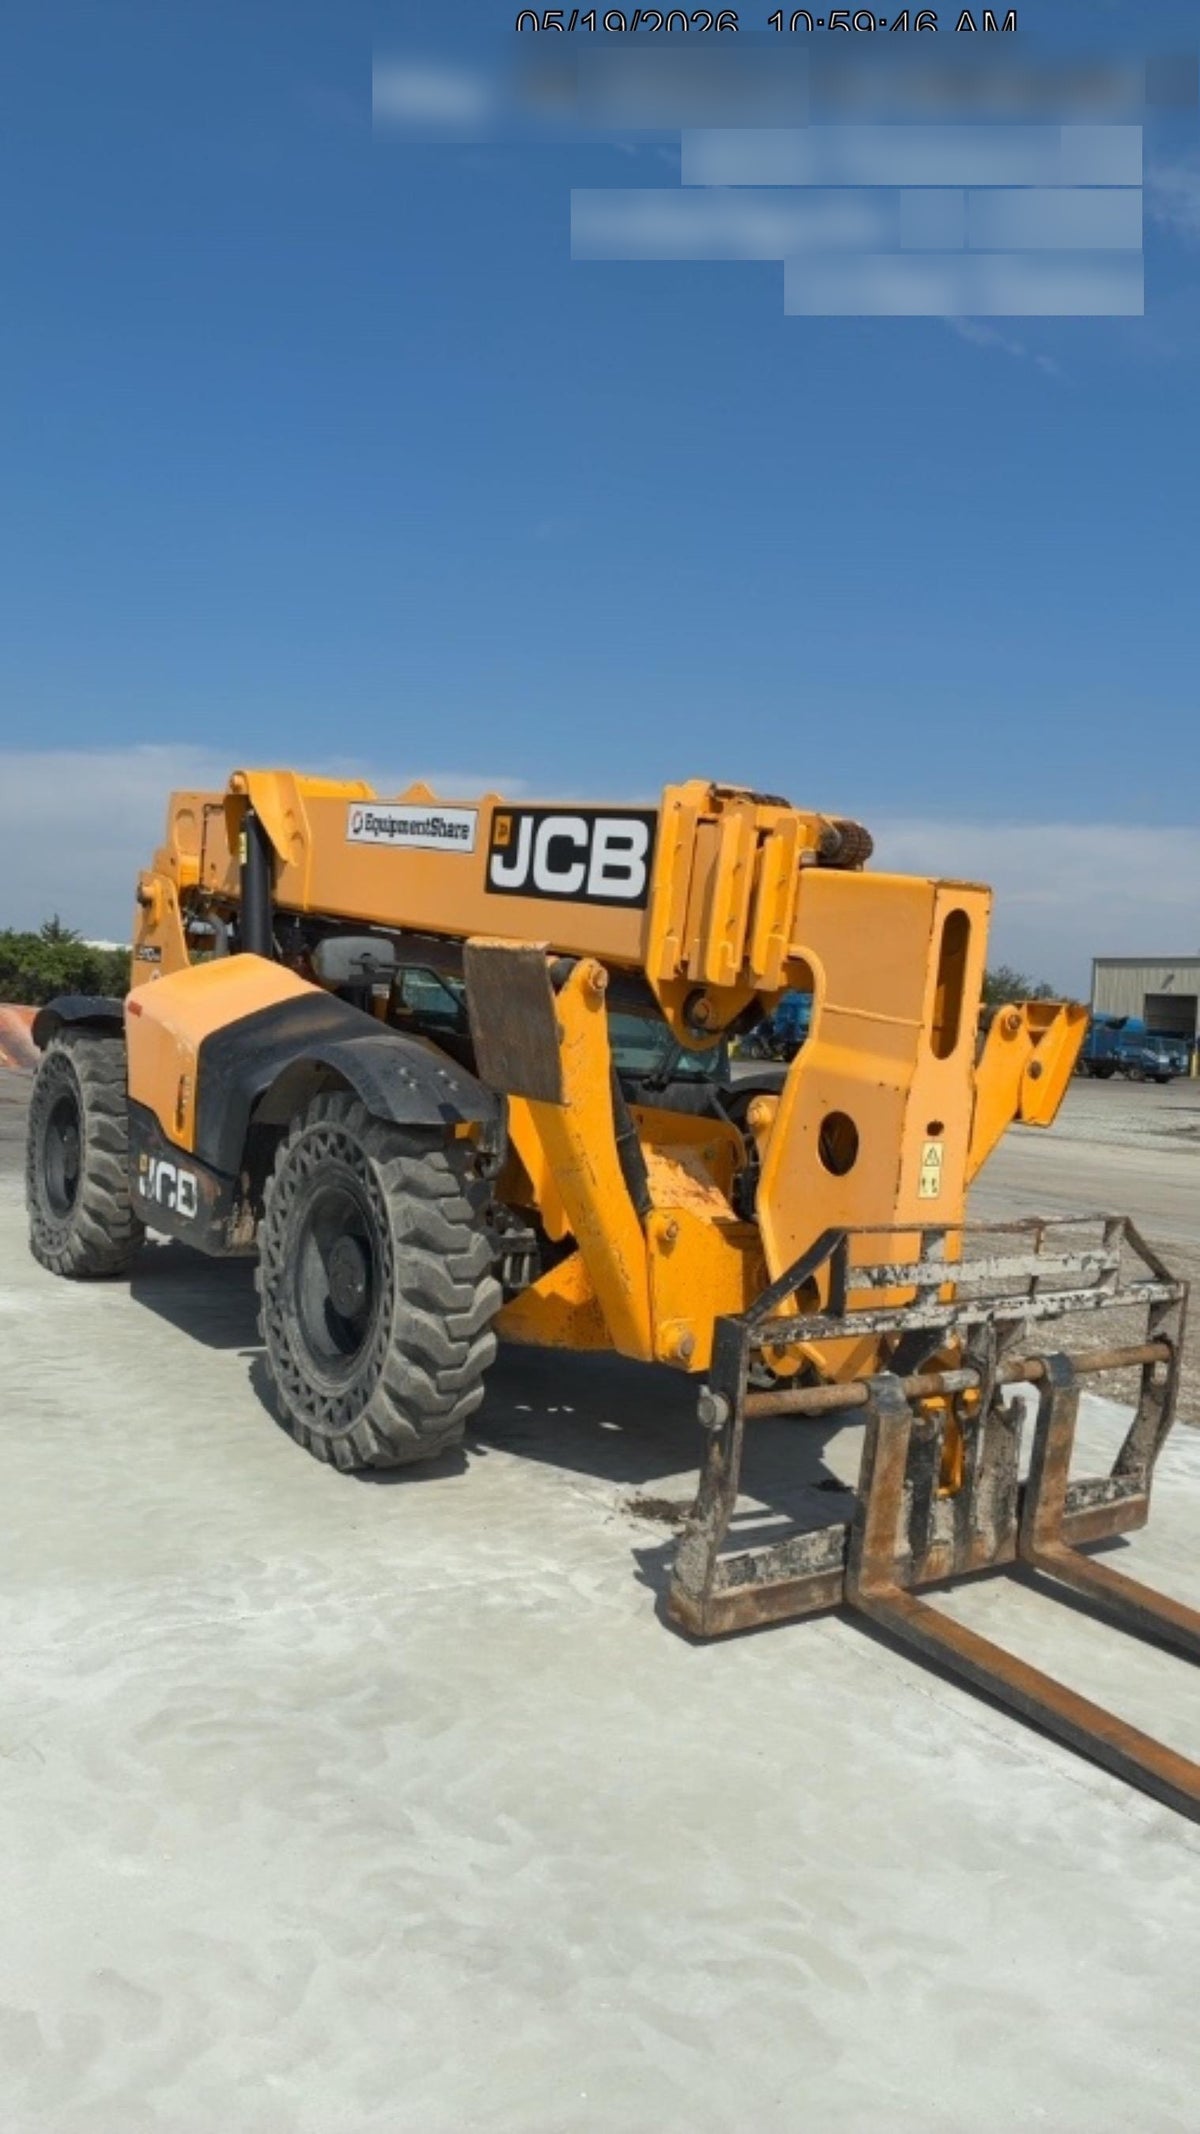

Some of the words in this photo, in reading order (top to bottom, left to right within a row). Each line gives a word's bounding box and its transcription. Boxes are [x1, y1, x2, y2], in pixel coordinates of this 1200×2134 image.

[365, 811, 470, 840] EquipmentShare
[490, 815, 649, 899] JCB
[139, 1156, 198, 1219] JCB
